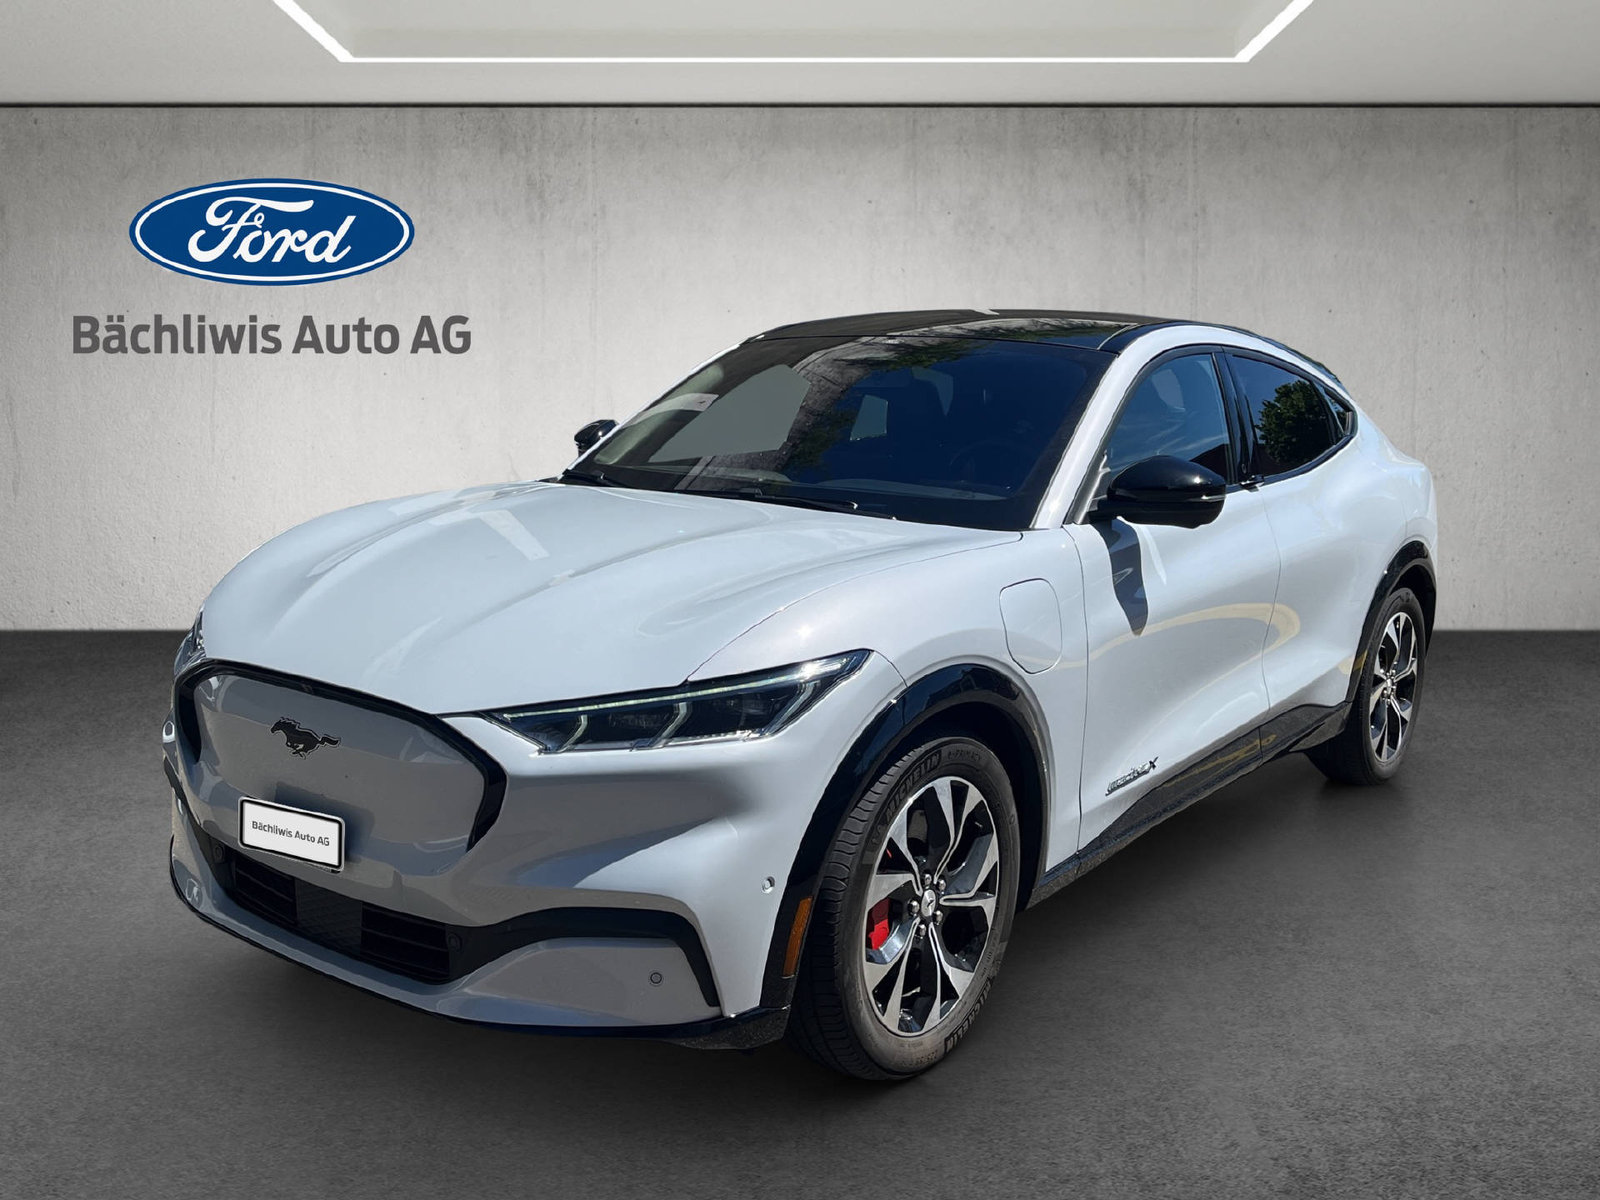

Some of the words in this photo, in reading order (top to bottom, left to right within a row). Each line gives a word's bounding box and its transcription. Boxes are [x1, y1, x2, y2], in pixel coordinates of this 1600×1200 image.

[188, 196, 356, 263] Ford
[72, 314, 282, 354] Bächliwis
[291, 315, 400, 354] Auto
[410, 315, 472, 354] AG
[252, 820, 292, 837] Bächliwis
[294, 830, 316, 843] Auto
[317, 836, 330, 847] AG
